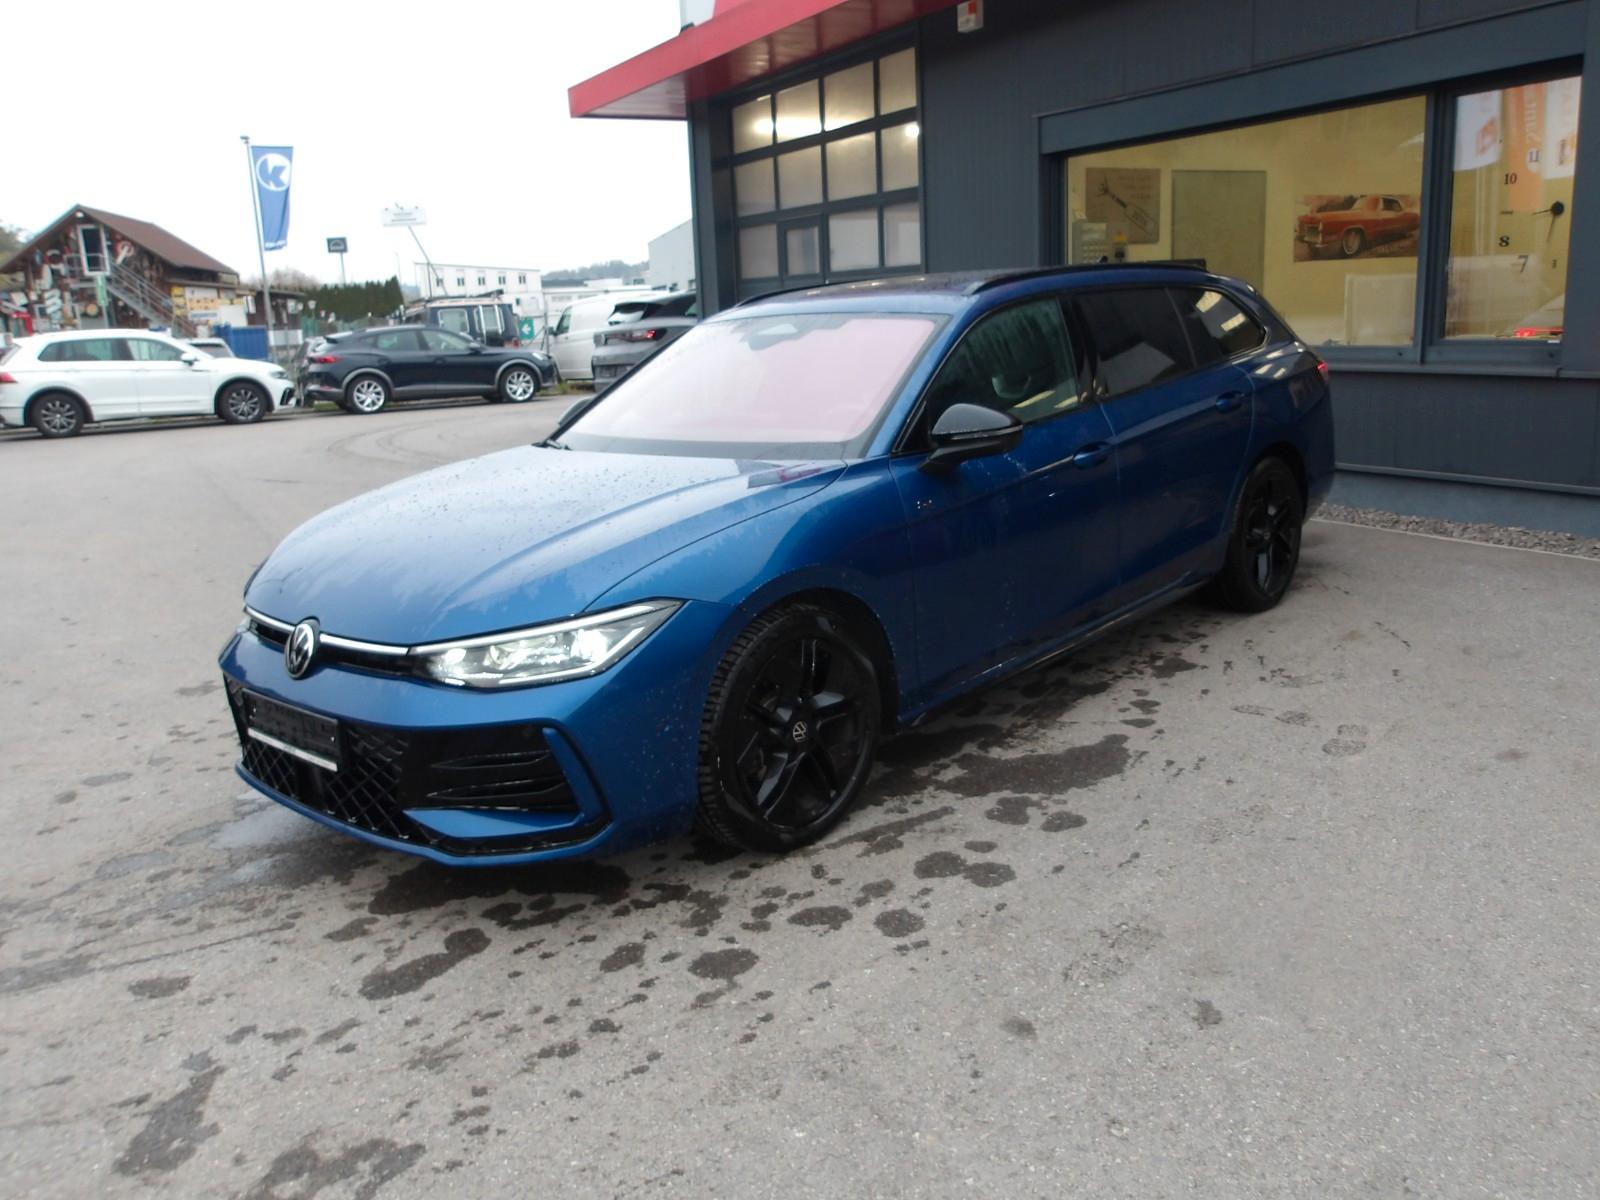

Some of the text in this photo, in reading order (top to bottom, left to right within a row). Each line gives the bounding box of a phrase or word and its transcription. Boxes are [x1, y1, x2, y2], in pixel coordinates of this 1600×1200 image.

[1504, 172, 1518, 185] 10
[1499, 235, 1510, 247] 8
[1518, 254, 1529, 273] 7
